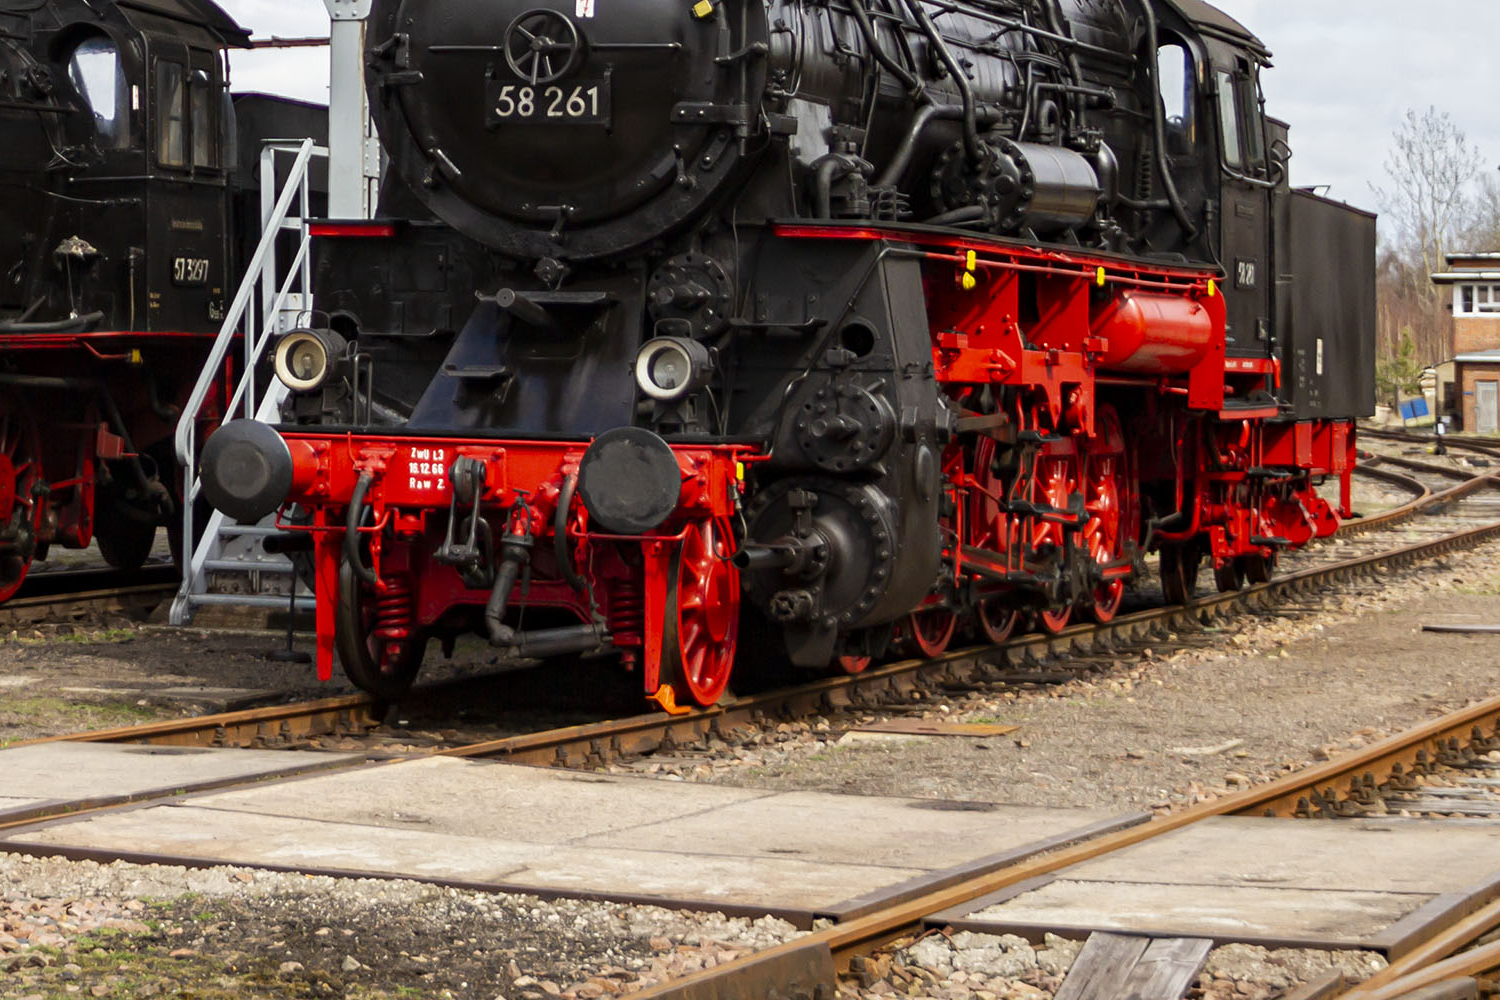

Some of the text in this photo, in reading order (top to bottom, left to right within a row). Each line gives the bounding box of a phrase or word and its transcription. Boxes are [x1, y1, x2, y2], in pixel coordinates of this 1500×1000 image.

[495, 85, 598, 117] 58 261
[174, 257, 209, 282] 57 3297
[409, 476, 431, 489] Raw
